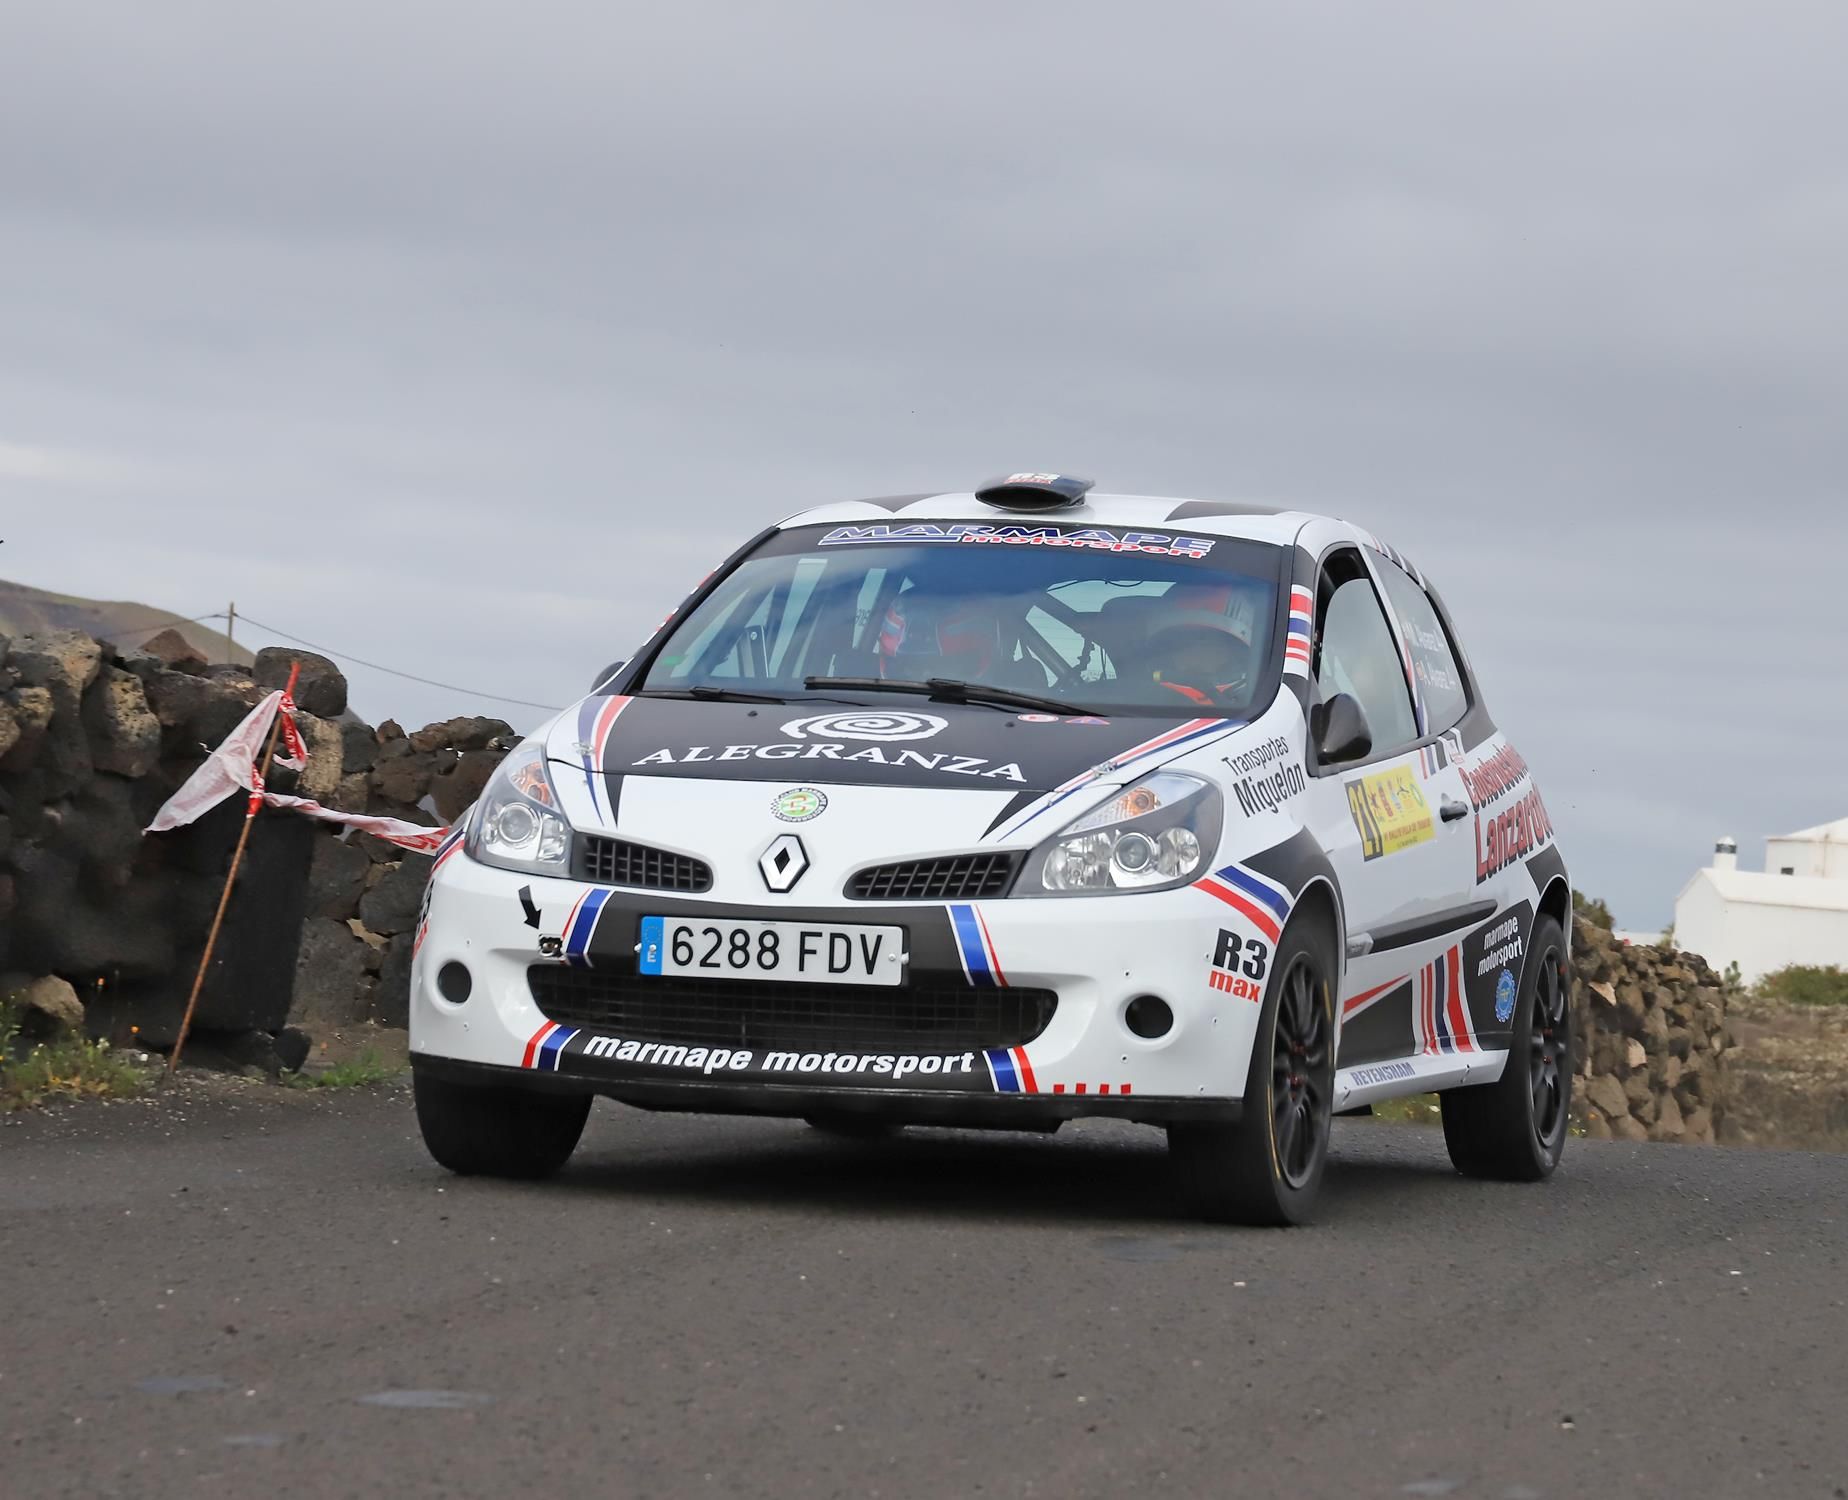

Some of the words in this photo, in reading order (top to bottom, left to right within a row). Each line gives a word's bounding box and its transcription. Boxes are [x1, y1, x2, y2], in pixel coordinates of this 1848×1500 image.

[822, 524, 1216, 551] MARMAPE
[961, 535, 1207, 559] motorsport
[631, 743, 1028, 783] ALEGRANZA
[1221, 736, 1289, 776] Transportes
[1232, 761, 1306, 818] Miguelon
[672, 926, 780, 970] 6288
[798, 931, 883, 975] FDV
[1484, 916, 1519, 951] marmape
[1212, 928, 1267, 980] R3
[1478, 935, 1522, 977] motorsport
[1209, 970, 1261, 1004] max
[583, 1035, 753, 1074] marmape
[761, 1050, 974, 1079] motorsport
